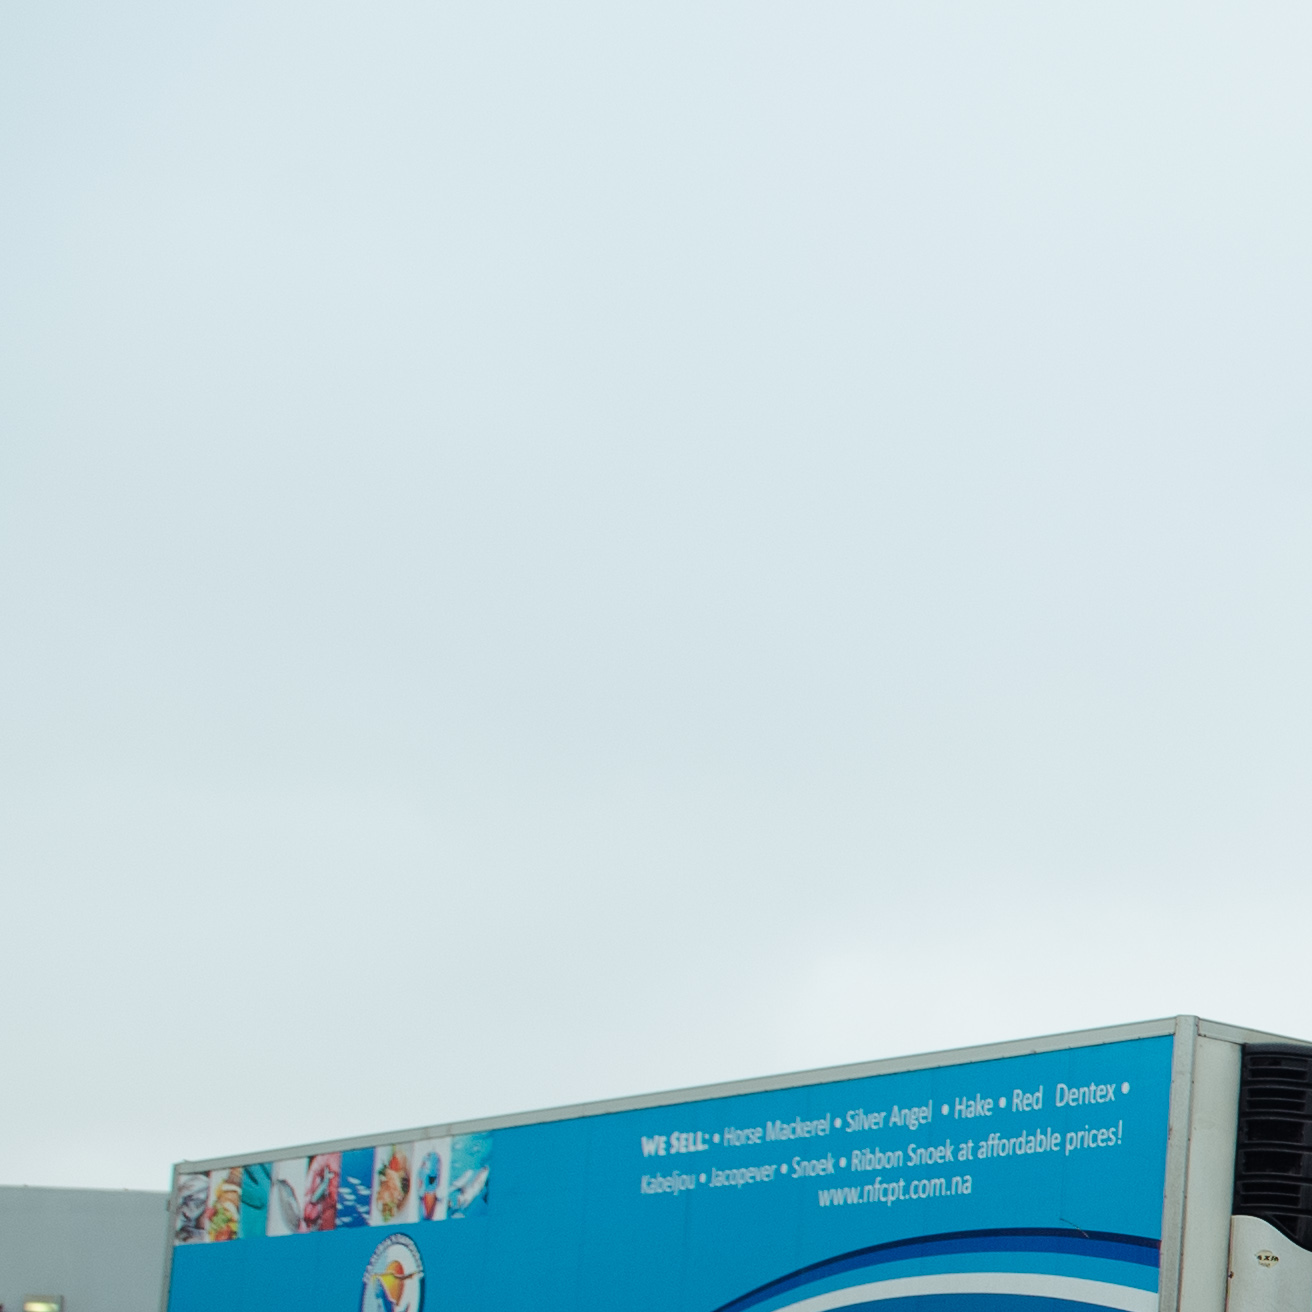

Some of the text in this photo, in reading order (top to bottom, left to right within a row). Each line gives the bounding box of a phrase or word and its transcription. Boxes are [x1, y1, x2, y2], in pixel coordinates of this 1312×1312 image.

[640, 1081, 1116, 1158] WE SELL: Horse Mackerel Silver Angel Hake Red Dentex
[640, 1119, 1123, 1196] Kabeljou Jacopever Snoek Ribbon Snoek at affordable prices!
[817, 1174, 973, 1208] www.nfcpt.com.na
